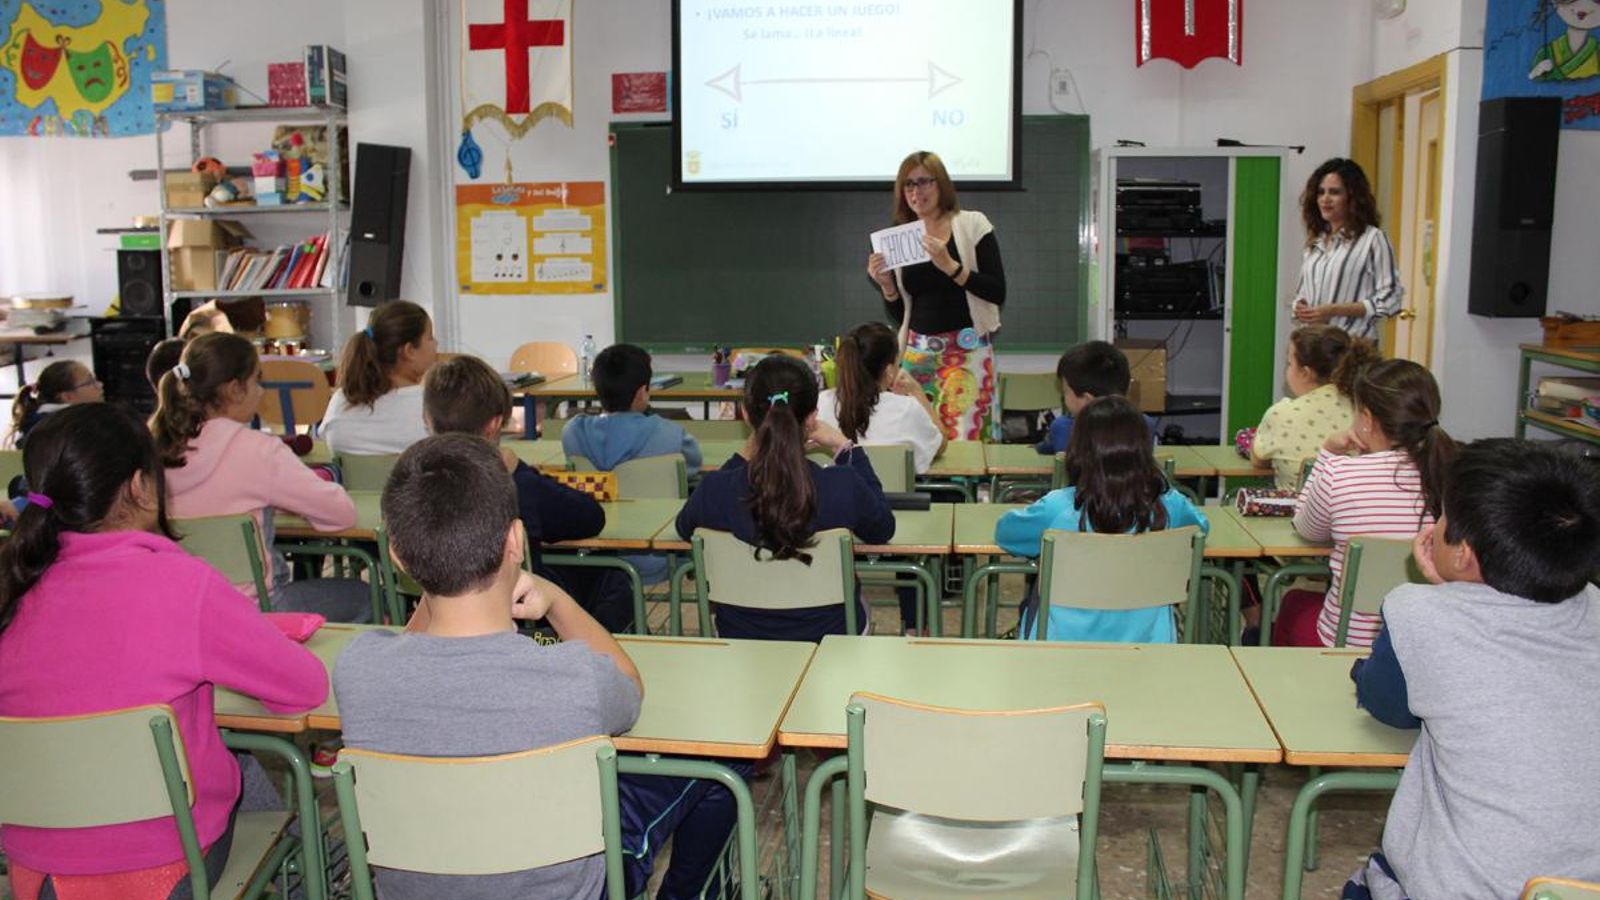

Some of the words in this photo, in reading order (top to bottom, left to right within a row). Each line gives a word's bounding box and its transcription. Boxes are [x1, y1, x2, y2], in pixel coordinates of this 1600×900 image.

[766, 6, 777, 18] A
[779, 5, 824, 17] HACER
[827, 4, 848, 16] UN
[852, 3, 901, 17] JUEGO!
[742, 27, 758, 40] Se
[721, 106, 738, 129] SÍ
[932, 109, 965, 128] NO
